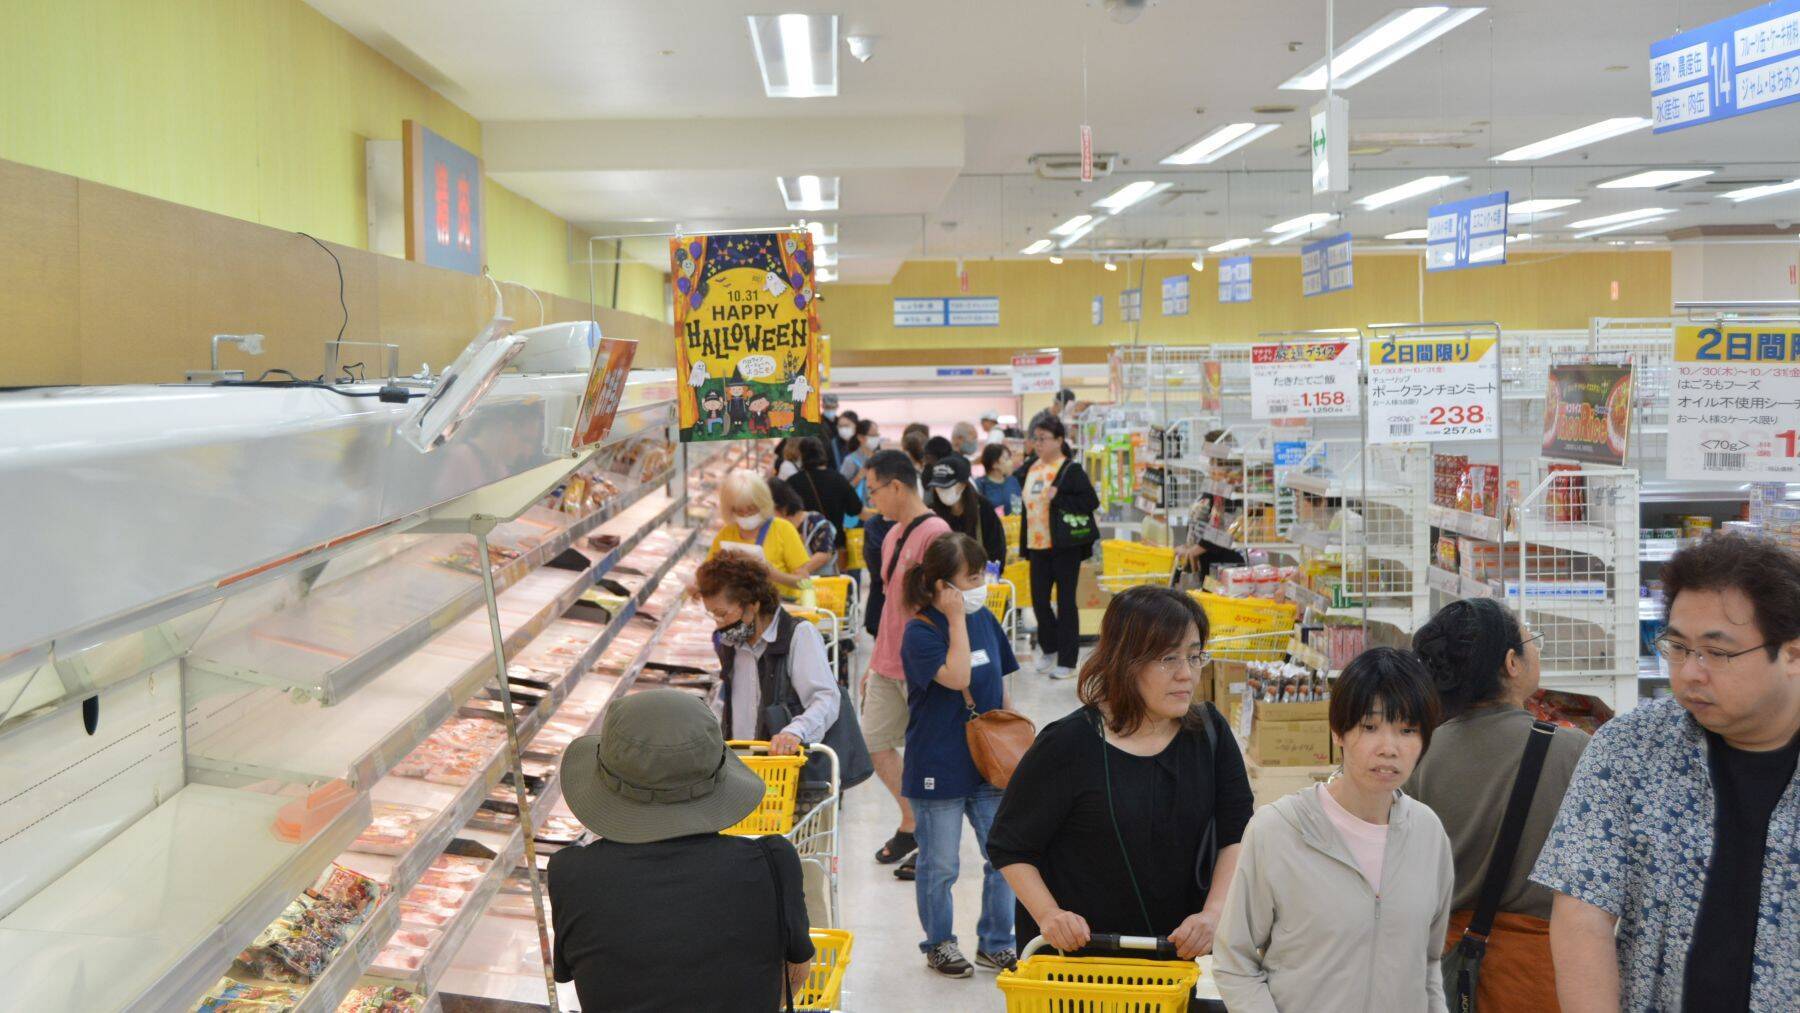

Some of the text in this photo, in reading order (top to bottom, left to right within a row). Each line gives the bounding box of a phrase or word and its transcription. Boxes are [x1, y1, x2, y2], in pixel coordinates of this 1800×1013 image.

[1710, 42, 1731, 107] 14
[728, 290, 758, 302] 10.31
[712, 304, 779, 321] HAPPY
[686, 319, 807, 360] HALLOWEEN
[1381, 342, 1470, 364] 2日間限り
[1372, 382, 1497, 398] ポークランチョンミート
[1677, 379, 1760, 391] はごろもフーズ
[1429, 405, 1485, 425] 238
[1676, 414, 1778, 425] お一人様3ケース限り
[1775, 430, 1800, 457] 1
